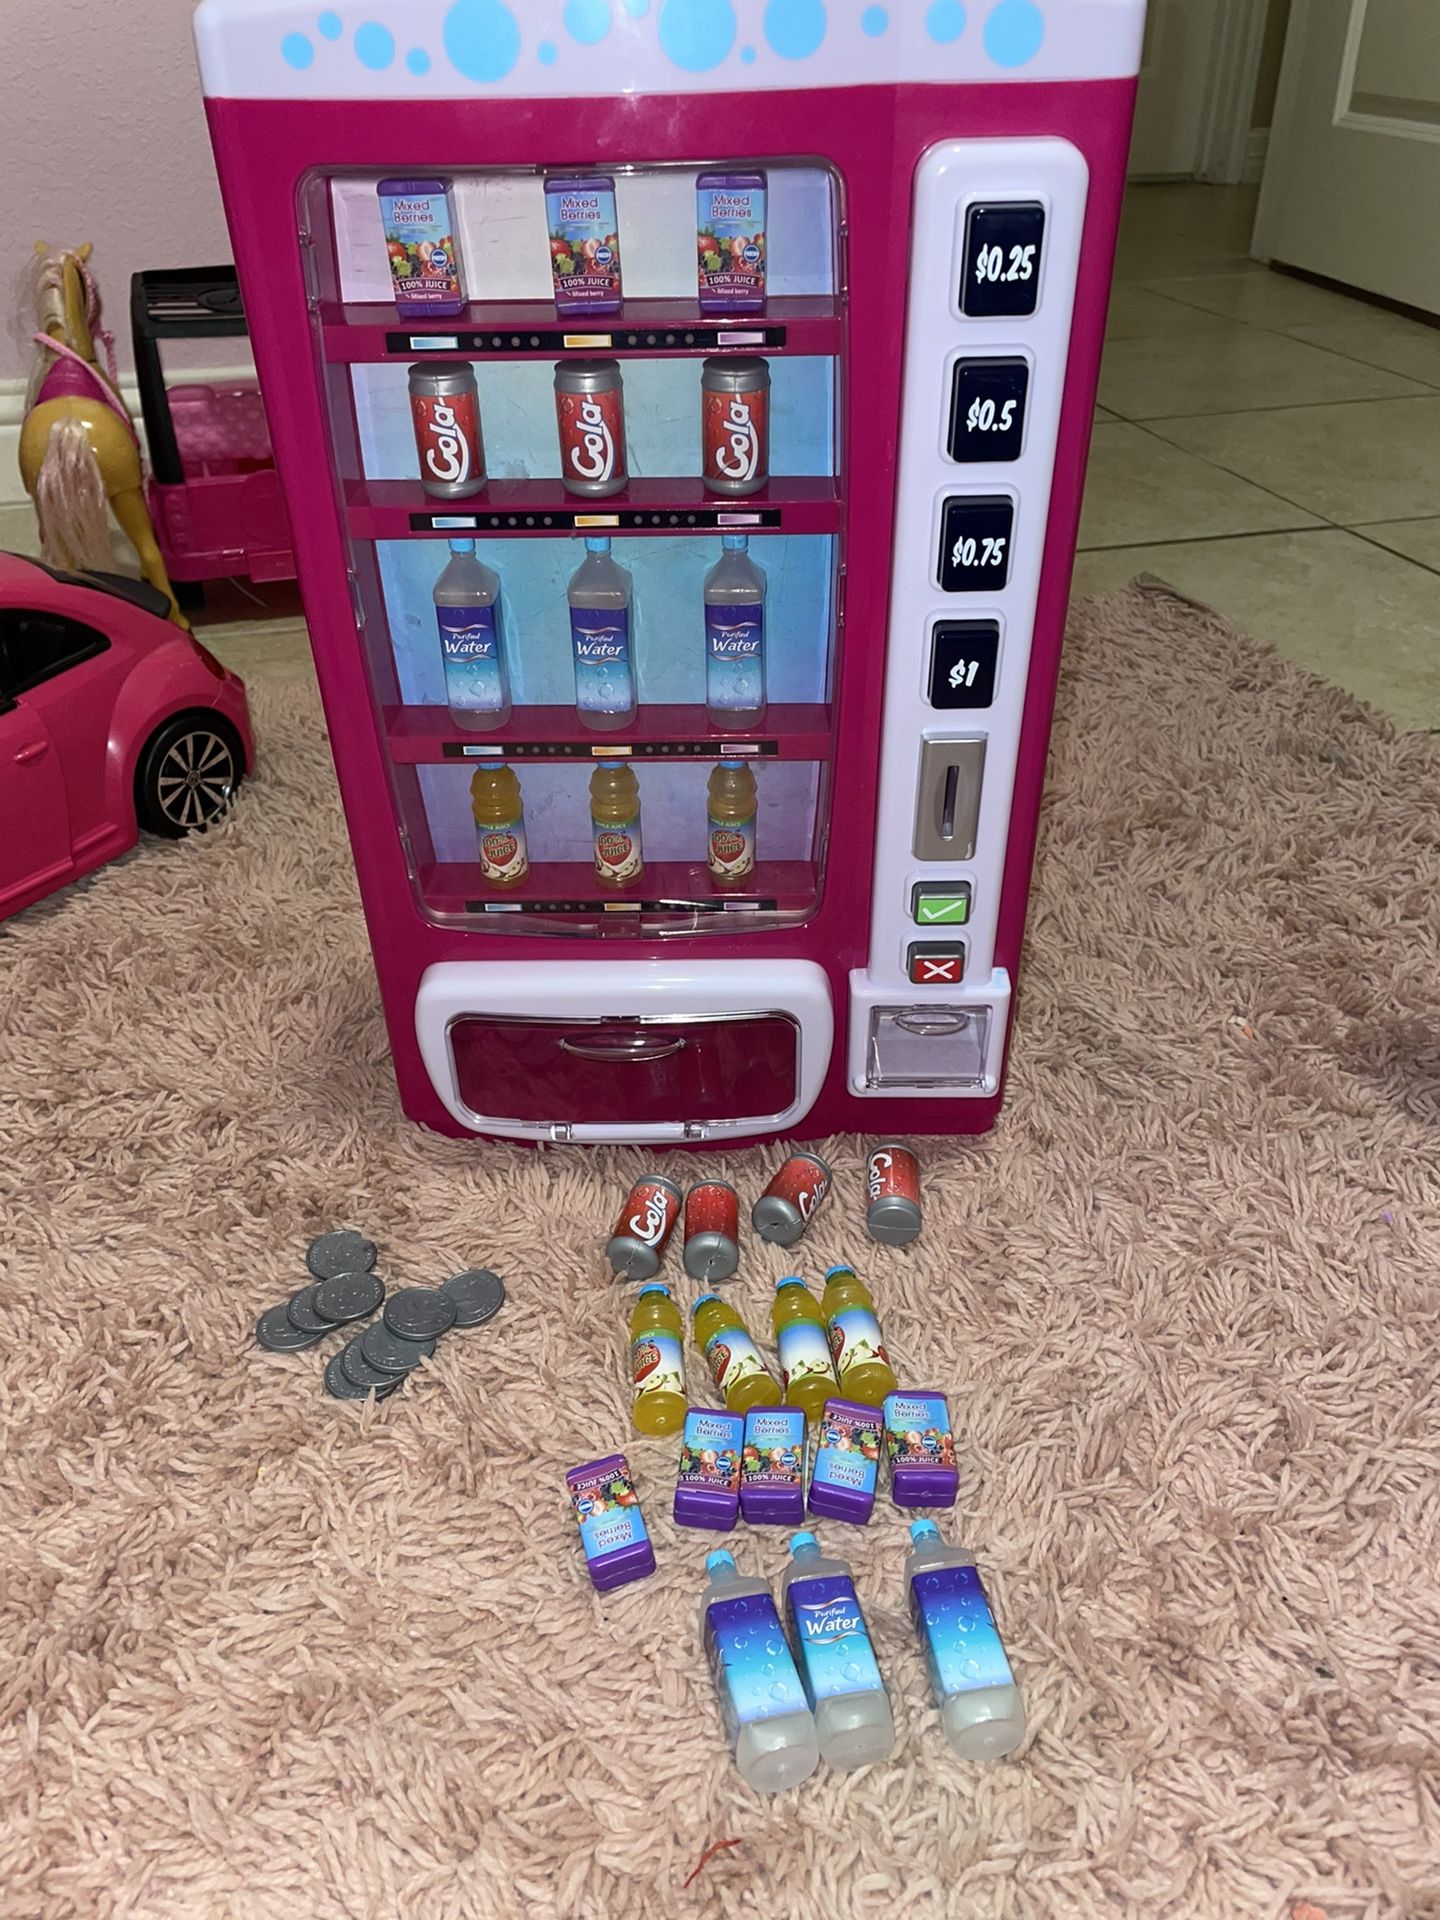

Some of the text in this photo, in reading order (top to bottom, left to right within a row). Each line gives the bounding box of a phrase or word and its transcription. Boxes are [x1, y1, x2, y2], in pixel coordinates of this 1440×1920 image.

[393, 199, 430, 211] Mixed
[561, 196, 598, 208] Mixed
[712, 194, 749, 206] Mixed
[393, 211, 433, 223] Berries
[560, 209, 601, 221] Berries
[711, 206, 752, 218] Berries
[975, 243, 1036, 284] $0.25
[401, 280, 447, 290] 100% JUICE
[563, 277, 610, 287] 100% JUICE
[709, 275, 757, 285] 100% JUICE
[966, 397, 1017, 432] $0.5
[427, 397, 465, 481] Cola
[571, 395, 609, 480] Cola
[716, 394, 754, 480] Cola
[951, 535, 1006, 567] $0.75
[451, 632, 481, 641] Purified
[585, 634, 613, 643] Purified
[721, 630, 750, 639] Purified
[444, 639, 492, 653] Water
[577, 641, 624, 655] Water
[712, 638, 760, 652] Water
[948, 658, 980, 689] $1
[870, 1153, 893, 1200] Cola
[799, 1180, 828, 1222] Cola
[630, 1187, 666, 1242] Cola
[895, 1402, 927, 1410] Mixed
[699, 1420, 731, 1430] Mixed
[757, 1418, 788, 1426] Mixed
[832, 1414, 874, 1429] 100% JUICE
[697, 1427, 732, 1438] Berries
[755, 1425, 790, 1434] Berries
[918, 1456, 940, 1464] JUICE
[829, 1462, 865, 1479] Berries
[685, 1474, 729, 1486] 100% JUICE
[748, 1474, 792, 1482] 100% JUICE
[829, 1471, 862, 1487] Mixed
[577, 1479, 598, 1490] JUICE
[599, 1531, 632, 1548] Mixed
[814, 1606, 846, 1618] Purified
[805, 1616, 860, 1636] Water
